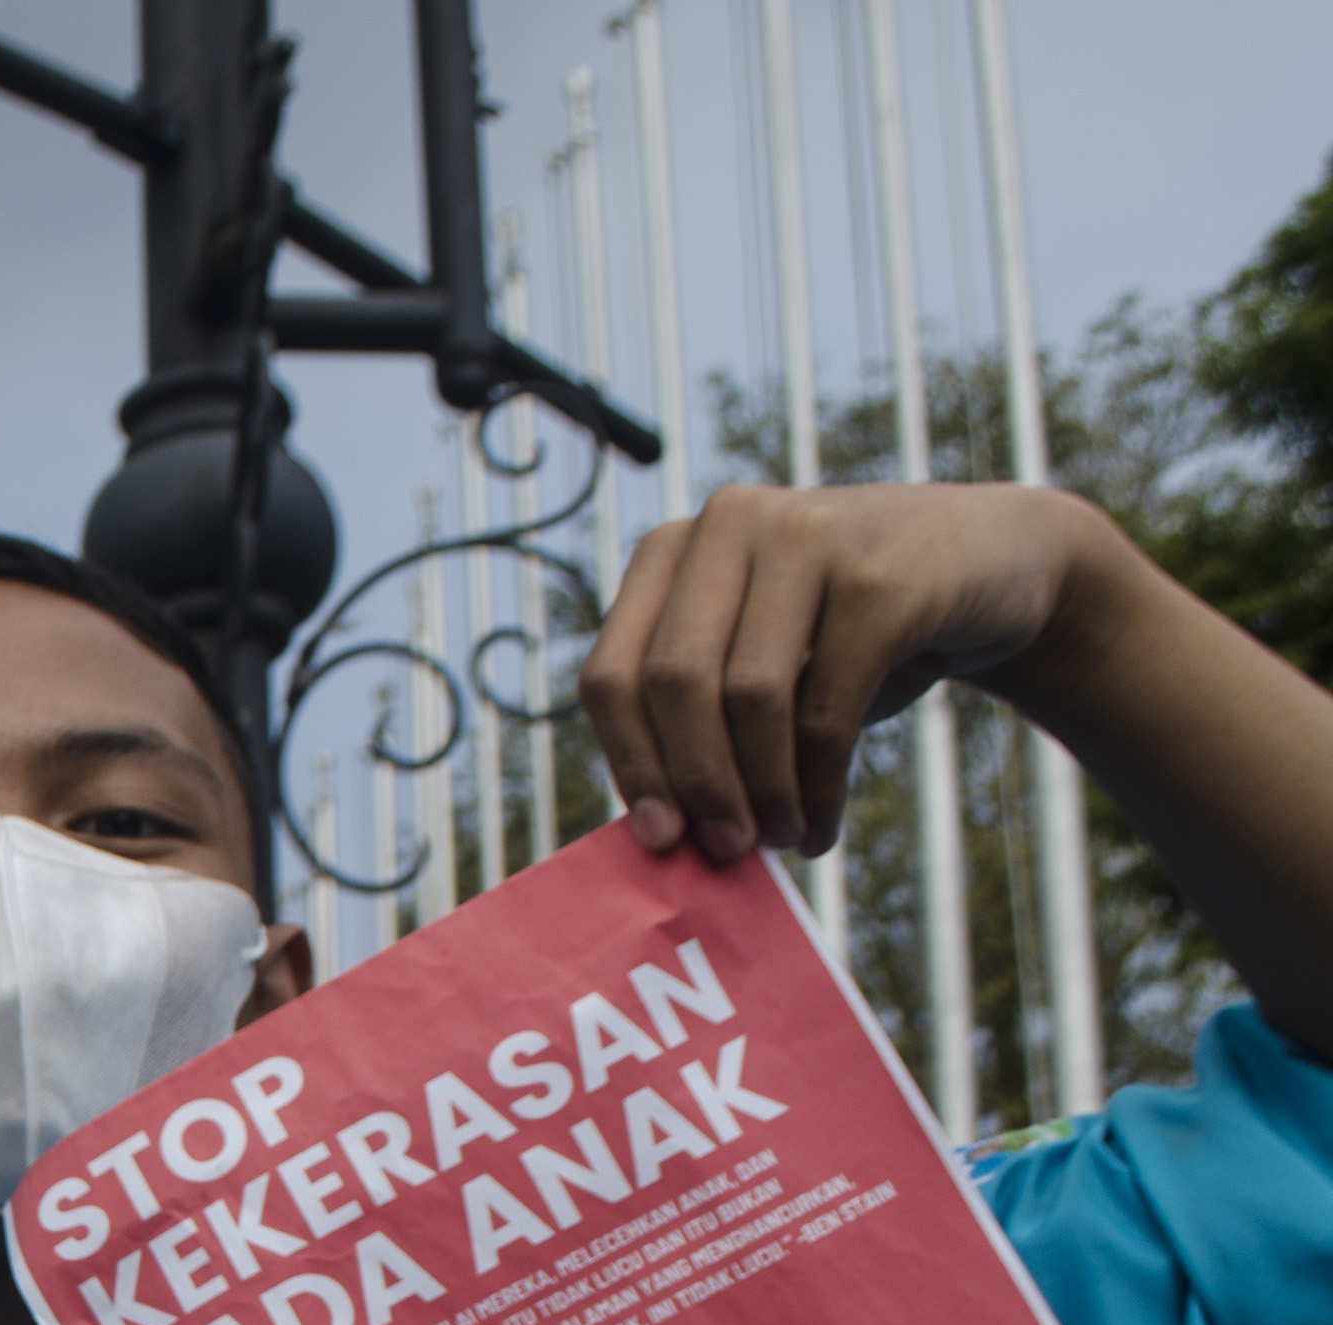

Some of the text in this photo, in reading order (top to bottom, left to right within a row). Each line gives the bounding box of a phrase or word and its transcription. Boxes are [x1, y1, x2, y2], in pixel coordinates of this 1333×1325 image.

[36, 1055, 305, 1262] STOP
[460, 1035, 788, 1276] ANAK
[472, 1262, 560, 1323] MEREKA,
[553, 1198, 681, 1281] MELECEHKAN
[675, 1167, 739, 1216] ANAK,
[733, 1147, 779, 1183] DAN
[535, 1275, 596, 1321] TIDAK
[590, 1249, 646, 1292] LUCU
[640, 1227, 688, 1265] DAN
[682, 1210, 721, 1243] ITU
[715, 1175, 785, 1226] BUKAN
[636, 1255, 694, 1300] YANG
[645, 1296, 679, 1325] INI
[674, 1265, 736, 1311] TIDAK
